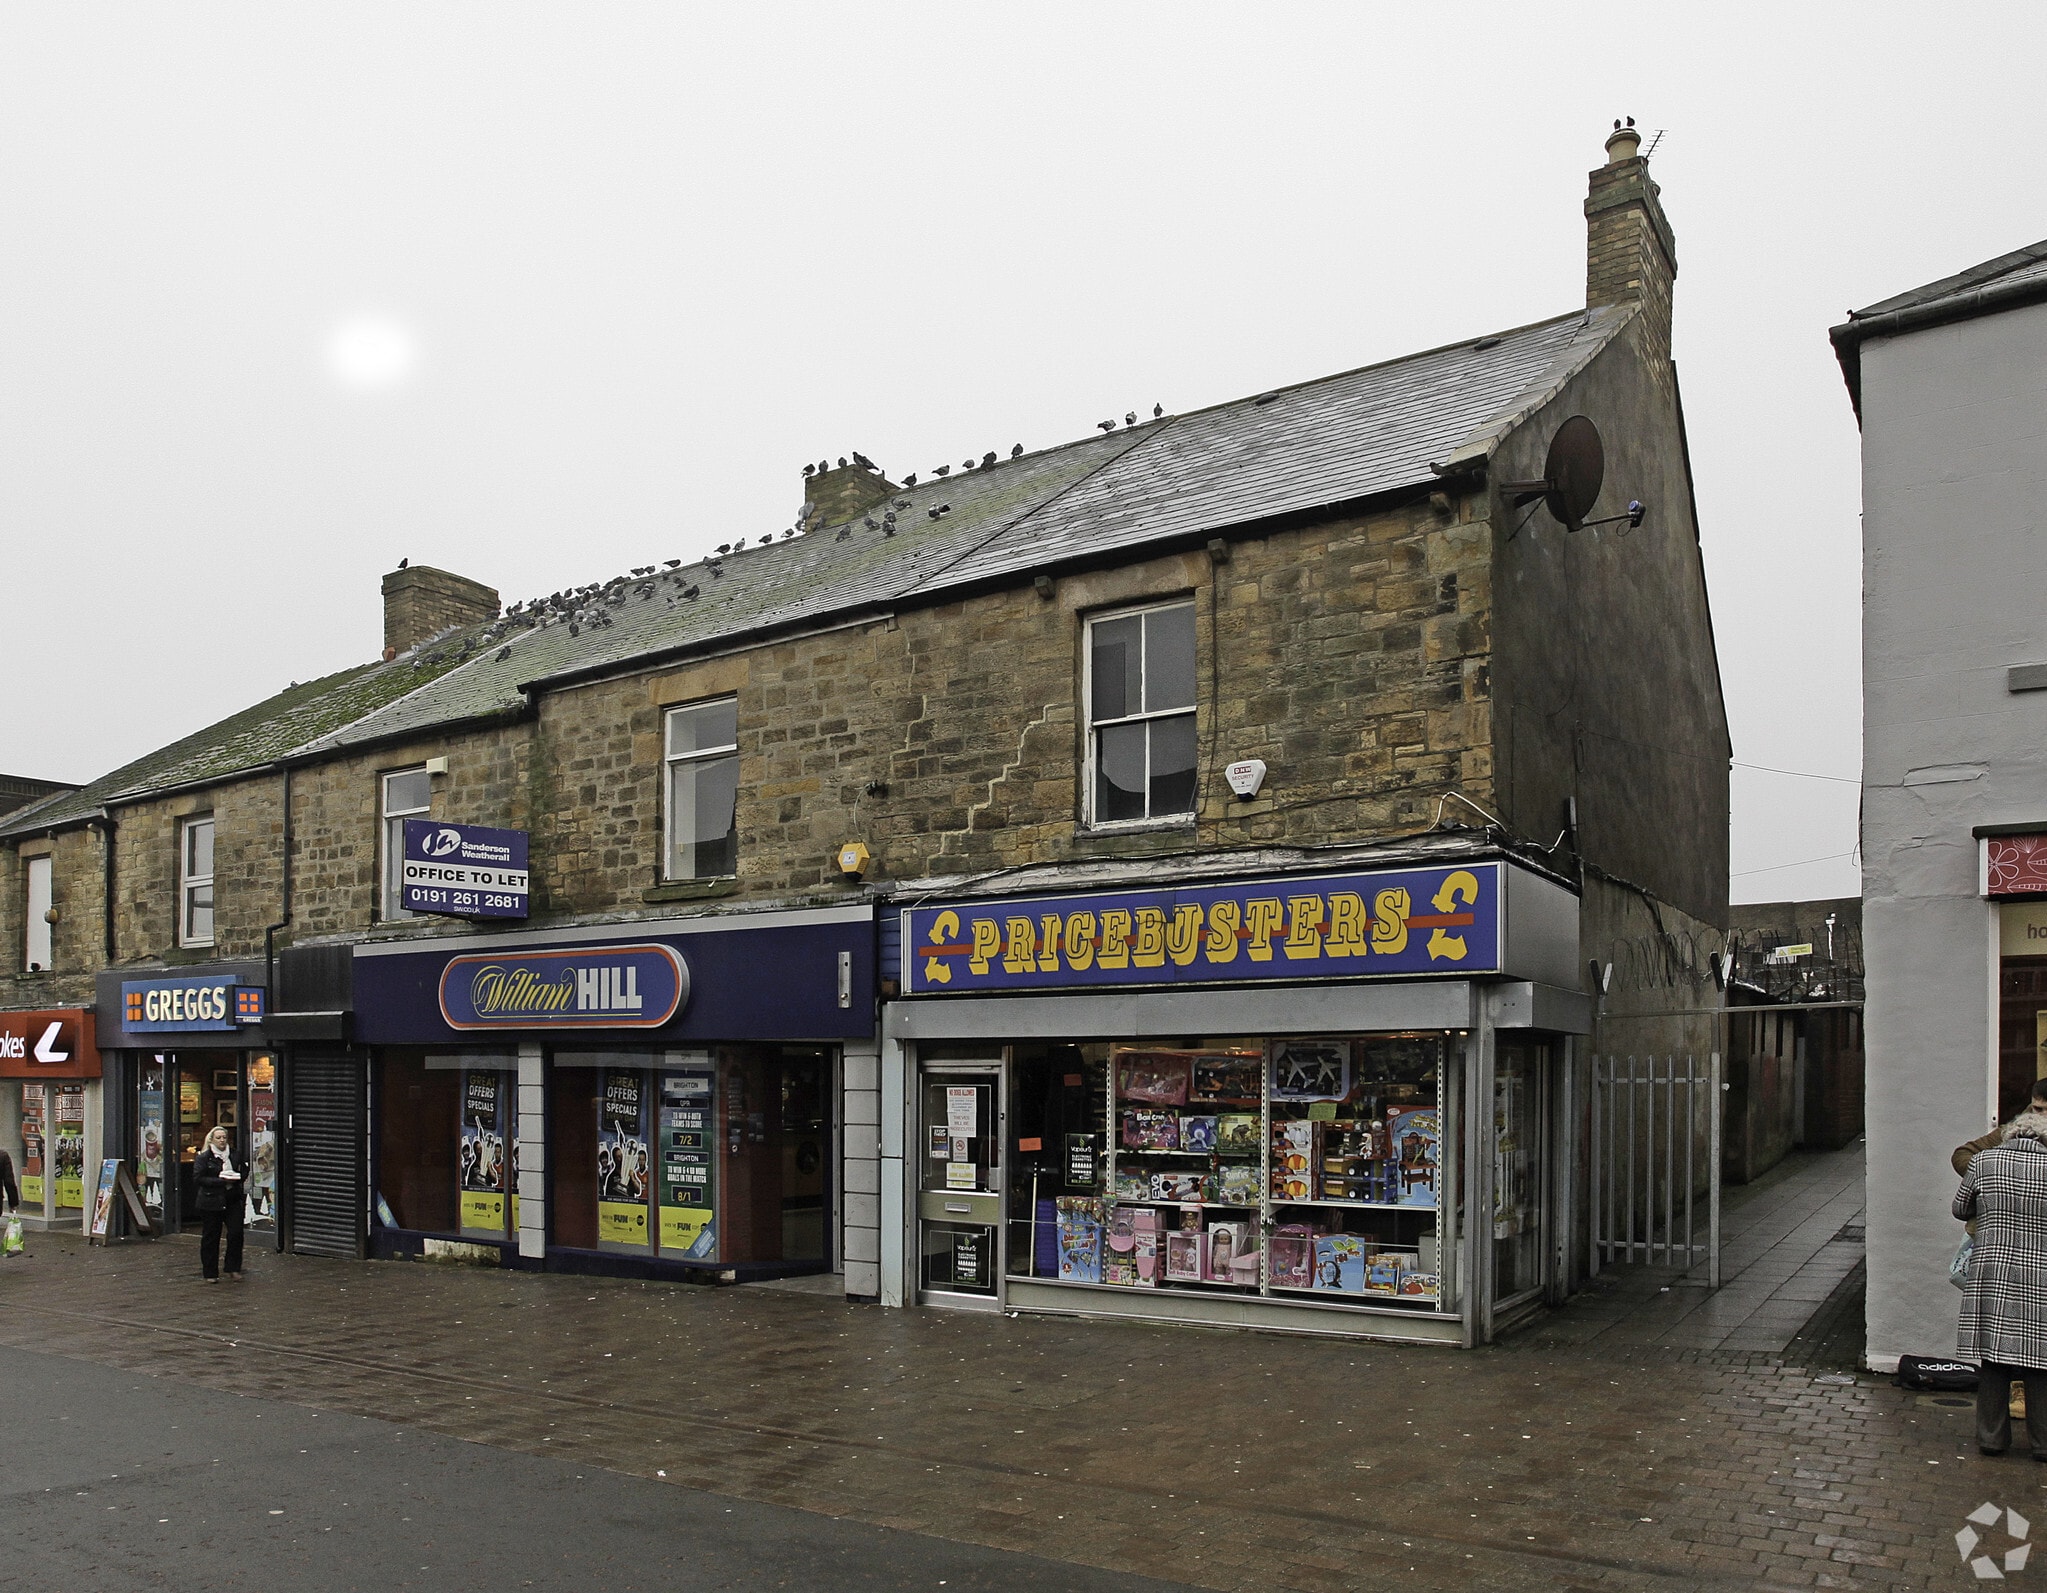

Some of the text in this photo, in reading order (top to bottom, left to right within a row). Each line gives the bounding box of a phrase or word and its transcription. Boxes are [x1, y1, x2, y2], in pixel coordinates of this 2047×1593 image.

[461, 841, 510, 853] Sanderson
[461, 849, 510, 862] Weatherall
[406, 866, 527, 887] OFFICE TO LET
[411, 888, 520, 909] 0191 261 2681
[969, 886, 1411, 976] PRICEBUSTERS
[470, 965, 643, 1013] William HILL
[145, 986, 226, 1022] GREGGS
[608, 1075, 639, 1089] GREAT
[673, 1081, 699, 1089] BRIGHTON
[469, 1085, 495, 1099] OFFERS
[607, 1086, 638, 1101] OFFERS
[467, 1099, 494, 1112] SPECIALS
[606, 1102, 638, 1116] SPECIALS
[679, 1135, 693, 1145] 7/2
[673, 1154, 699, 1162] BRIGHTON
[1151, 1174, 1160, 1200] EVO
[677, 1191, 691, 1201] 8/1
[613, 1214, 628, 1223] FUN
[677, 1222, 691, 1231] FUN
[1917, 1362, 1976, 1373] adidas
